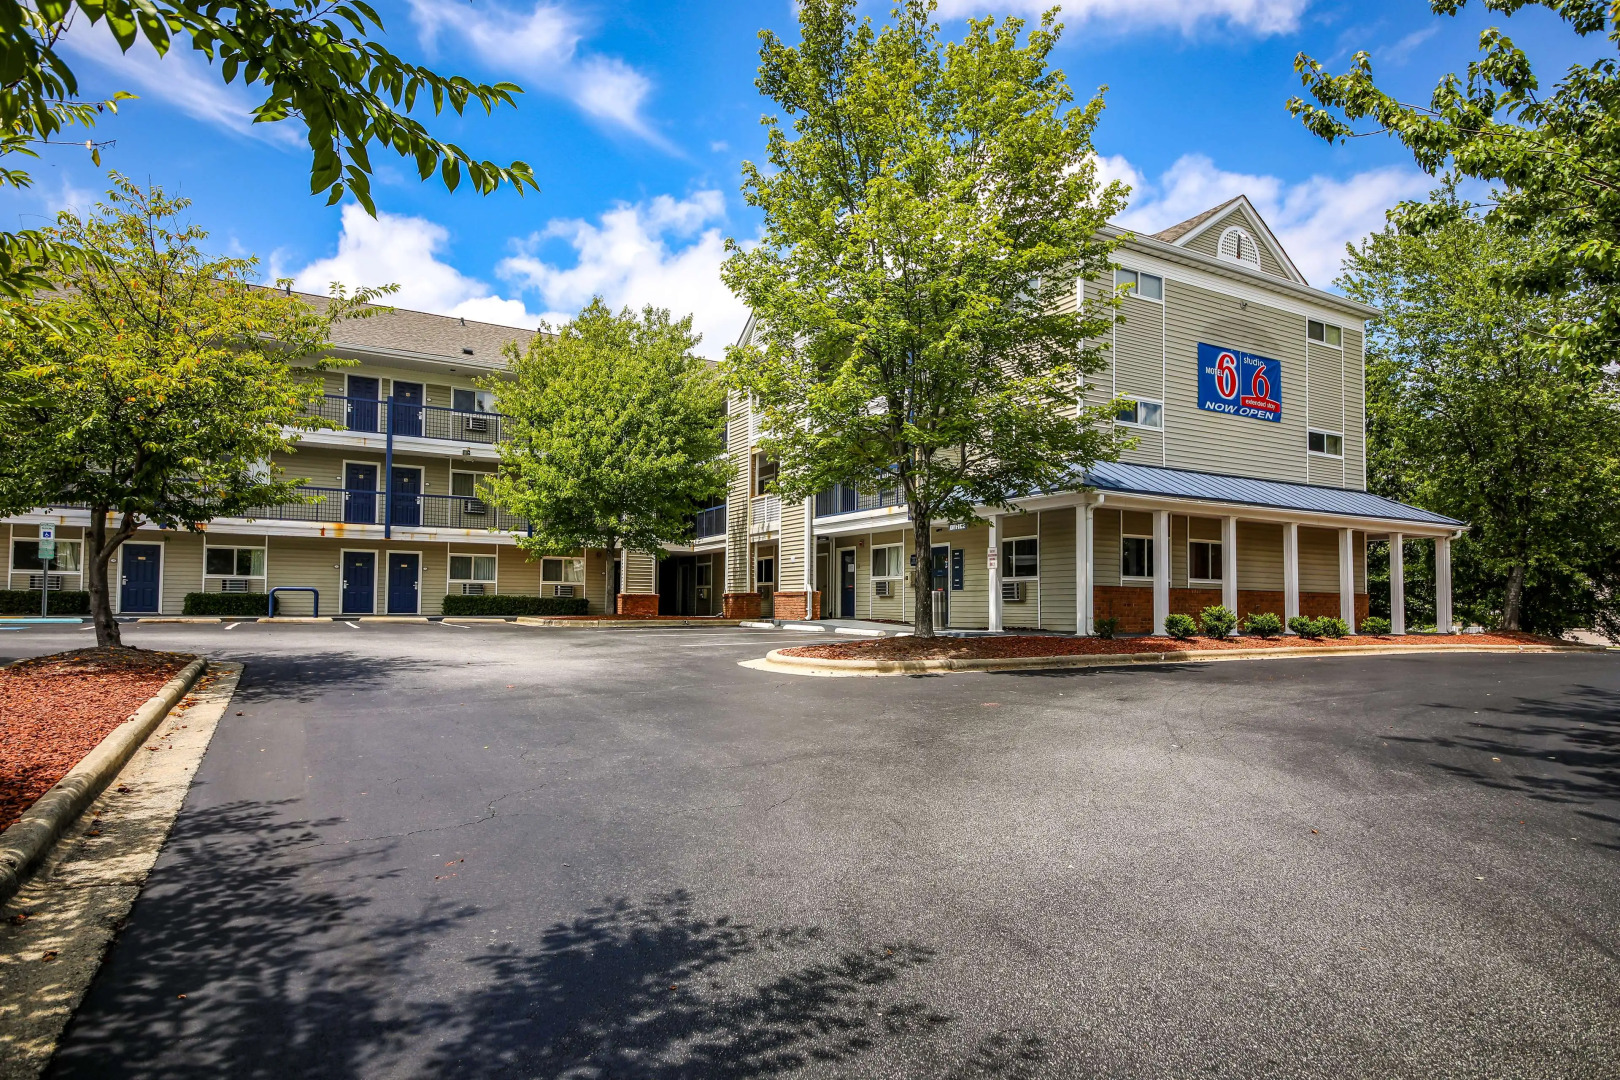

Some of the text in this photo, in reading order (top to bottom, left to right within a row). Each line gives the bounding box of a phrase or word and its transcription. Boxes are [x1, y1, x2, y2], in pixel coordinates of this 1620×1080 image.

[1244, 356, 1264, 366] studio
[1206, 352, 1238, 400] MOTEL 6
[1252, 365, 1270, 398] 6
[1205, 401, 1274, 420] NOW OPEN
[1246, 399, 1266, 407] extended
